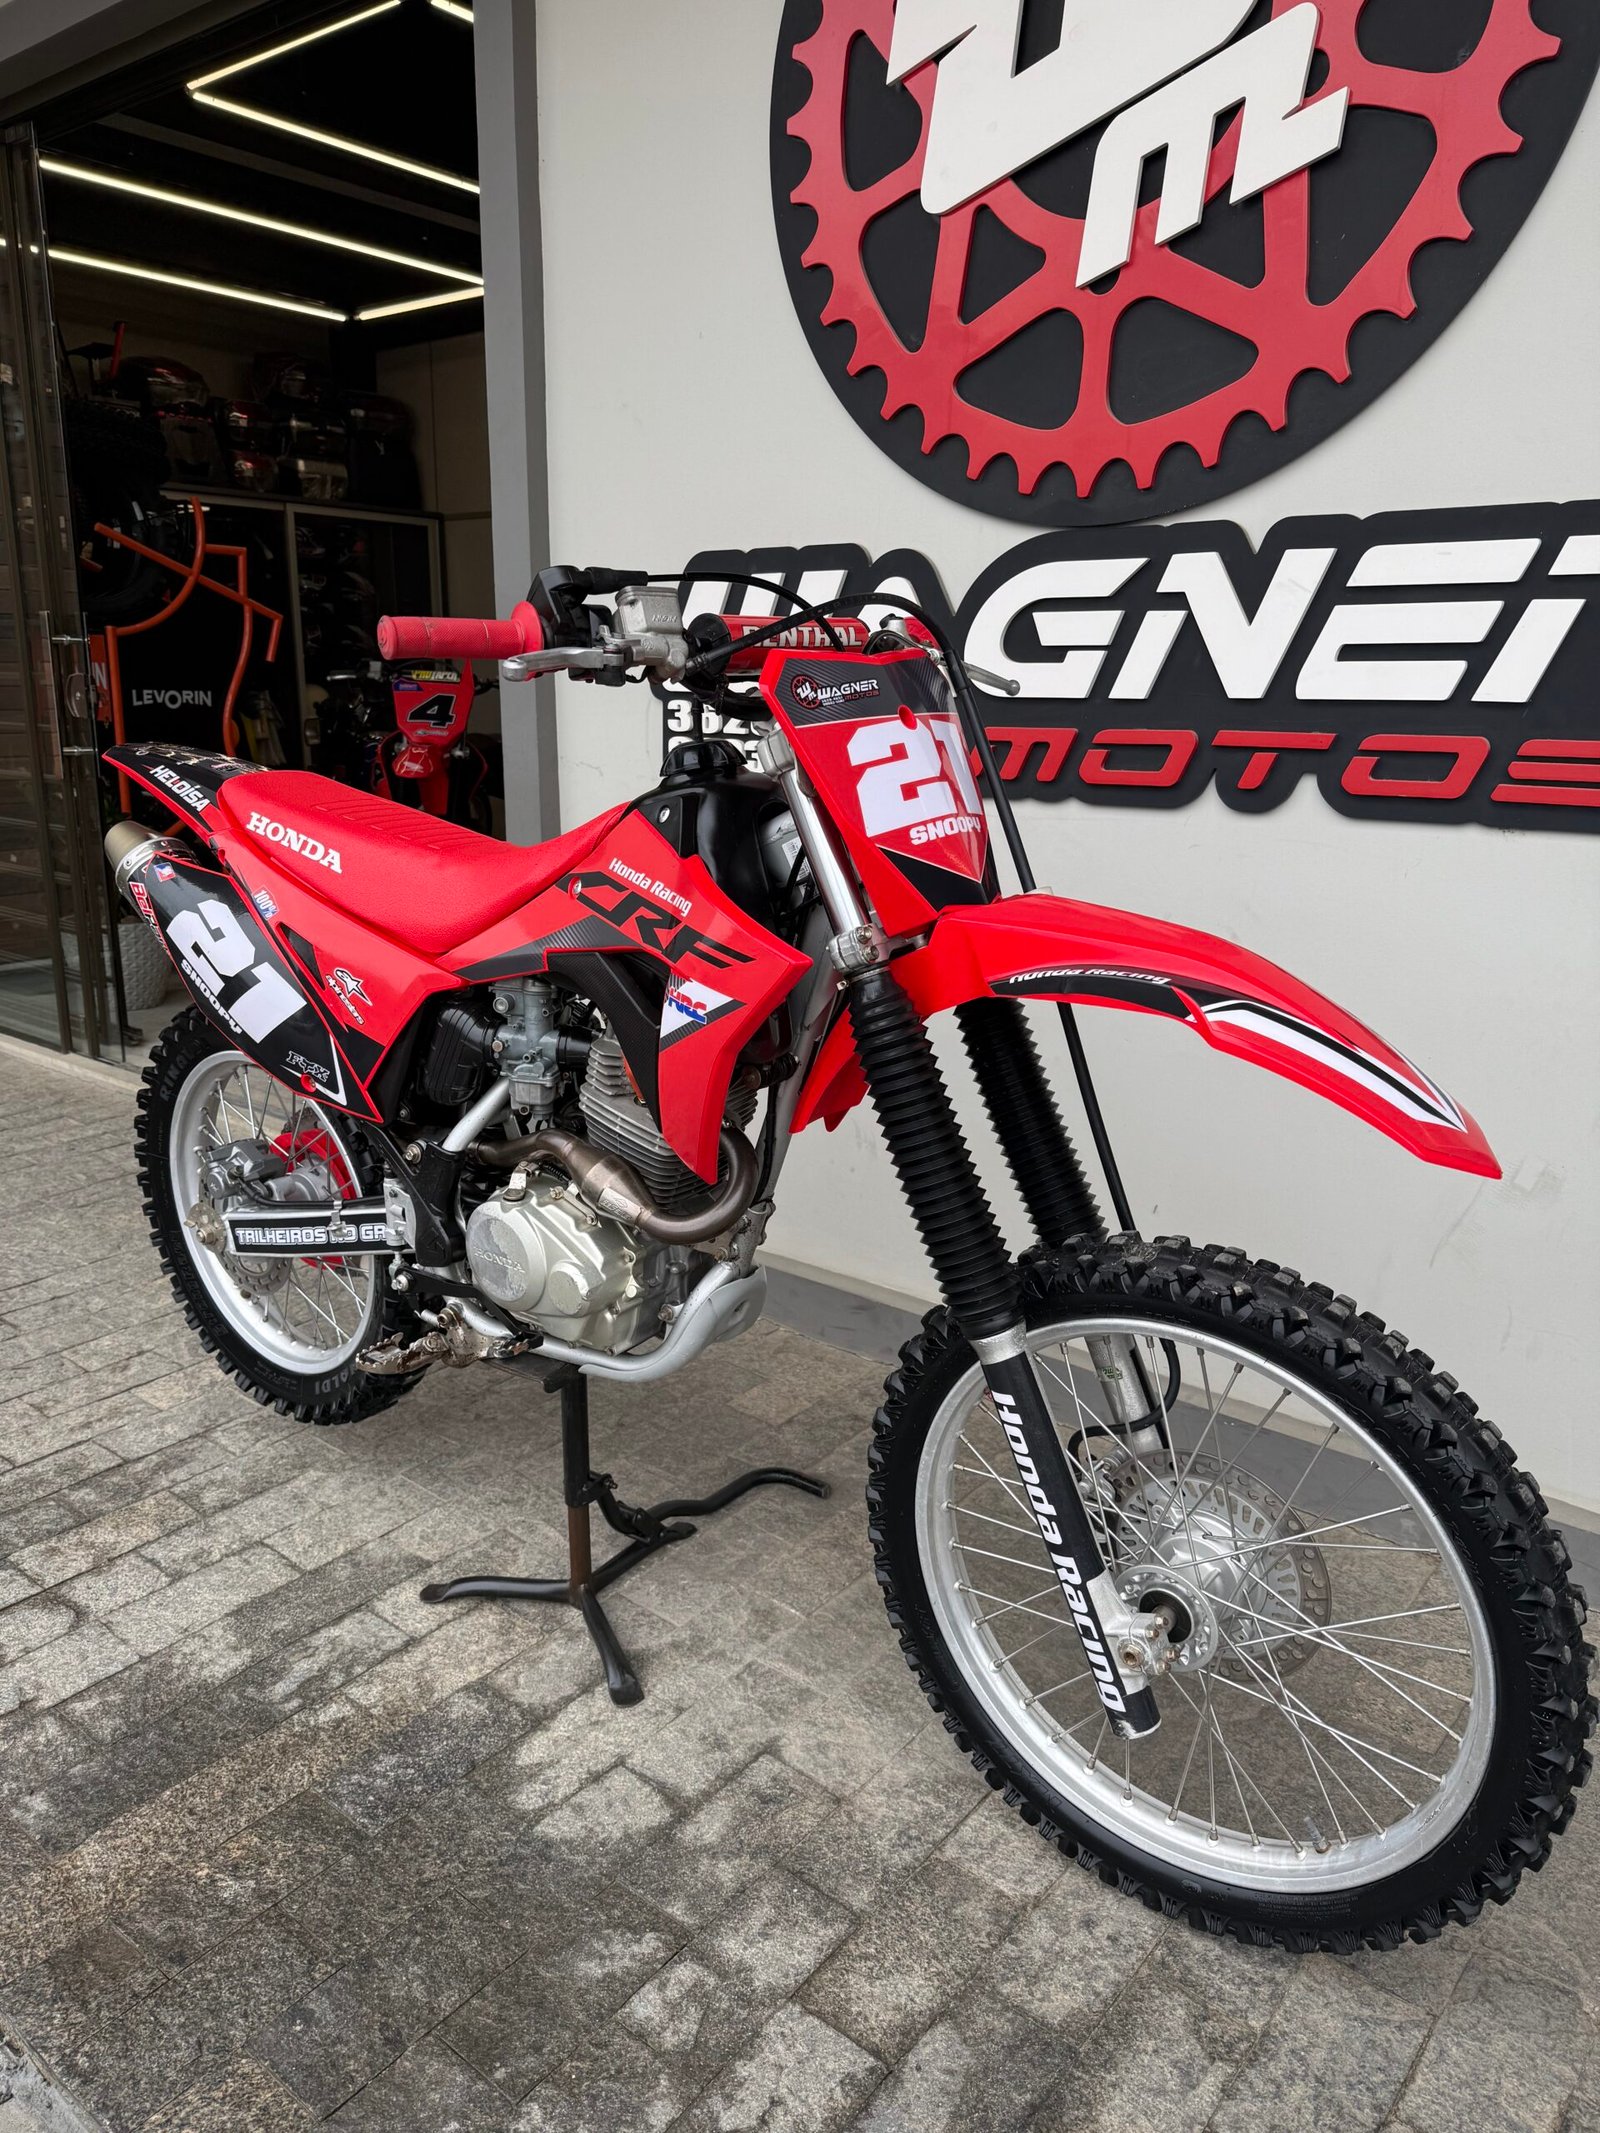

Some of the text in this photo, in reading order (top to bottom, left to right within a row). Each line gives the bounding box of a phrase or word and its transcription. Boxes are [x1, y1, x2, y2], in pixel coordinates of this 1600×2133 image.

[132, 689, 212, 709] LEVORIN
[817, 679, 879, 700] WAGNER
[844, 690, 880, 701] MOTOS
[407, 693, 456, 728] 4
[150, 765, 211, 813] HELOÍSA
[847, 718, 983, 838] 21
[246, 812, 342, 874] HONDA
[909, 816, 982, 846] SNOOPY
[253, 889, 278, 918] 100%
[608, 857, 693, 918] Honda Racing
[553, 870, 757, 970] CRF
[166, 899, 308, 1044] 21
[1009, 967, 1173, 985] Honda Racing
[180, 959, 243, 1035] SNOOPY
[668, 987, 708, 1025] HRC
[285, 1050, 331, 1083] FOX
[234, 1226, 328, 1246] TRILHEIROS
[473, 1246, 526, 1274] HONDA
[991, 1390, 1129, 1713] Honda Racing
